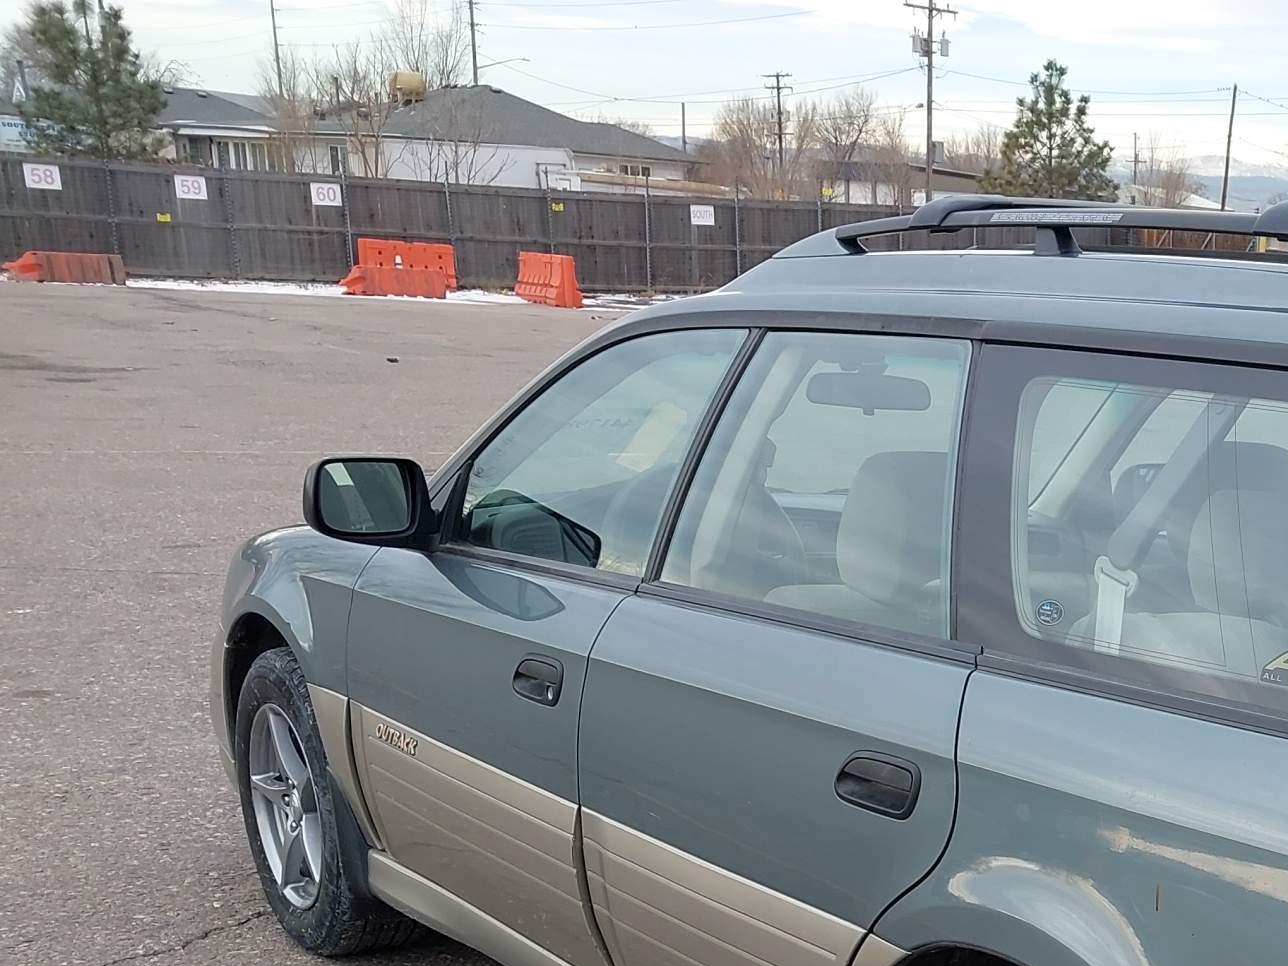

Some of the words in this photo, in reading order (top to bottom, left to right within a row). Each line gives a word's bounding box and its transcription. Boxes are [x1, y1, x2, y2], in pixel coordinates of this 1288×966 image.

[30, 167, 55, 185] 58
[180, 179, 202, 195] 59
[316, 186, 337, 201] 60
[692, 209, 713, 219] SOUTH
[1262, 672, 1281, 682] ALL
[375, 723, 418, 756] OUTBACK
